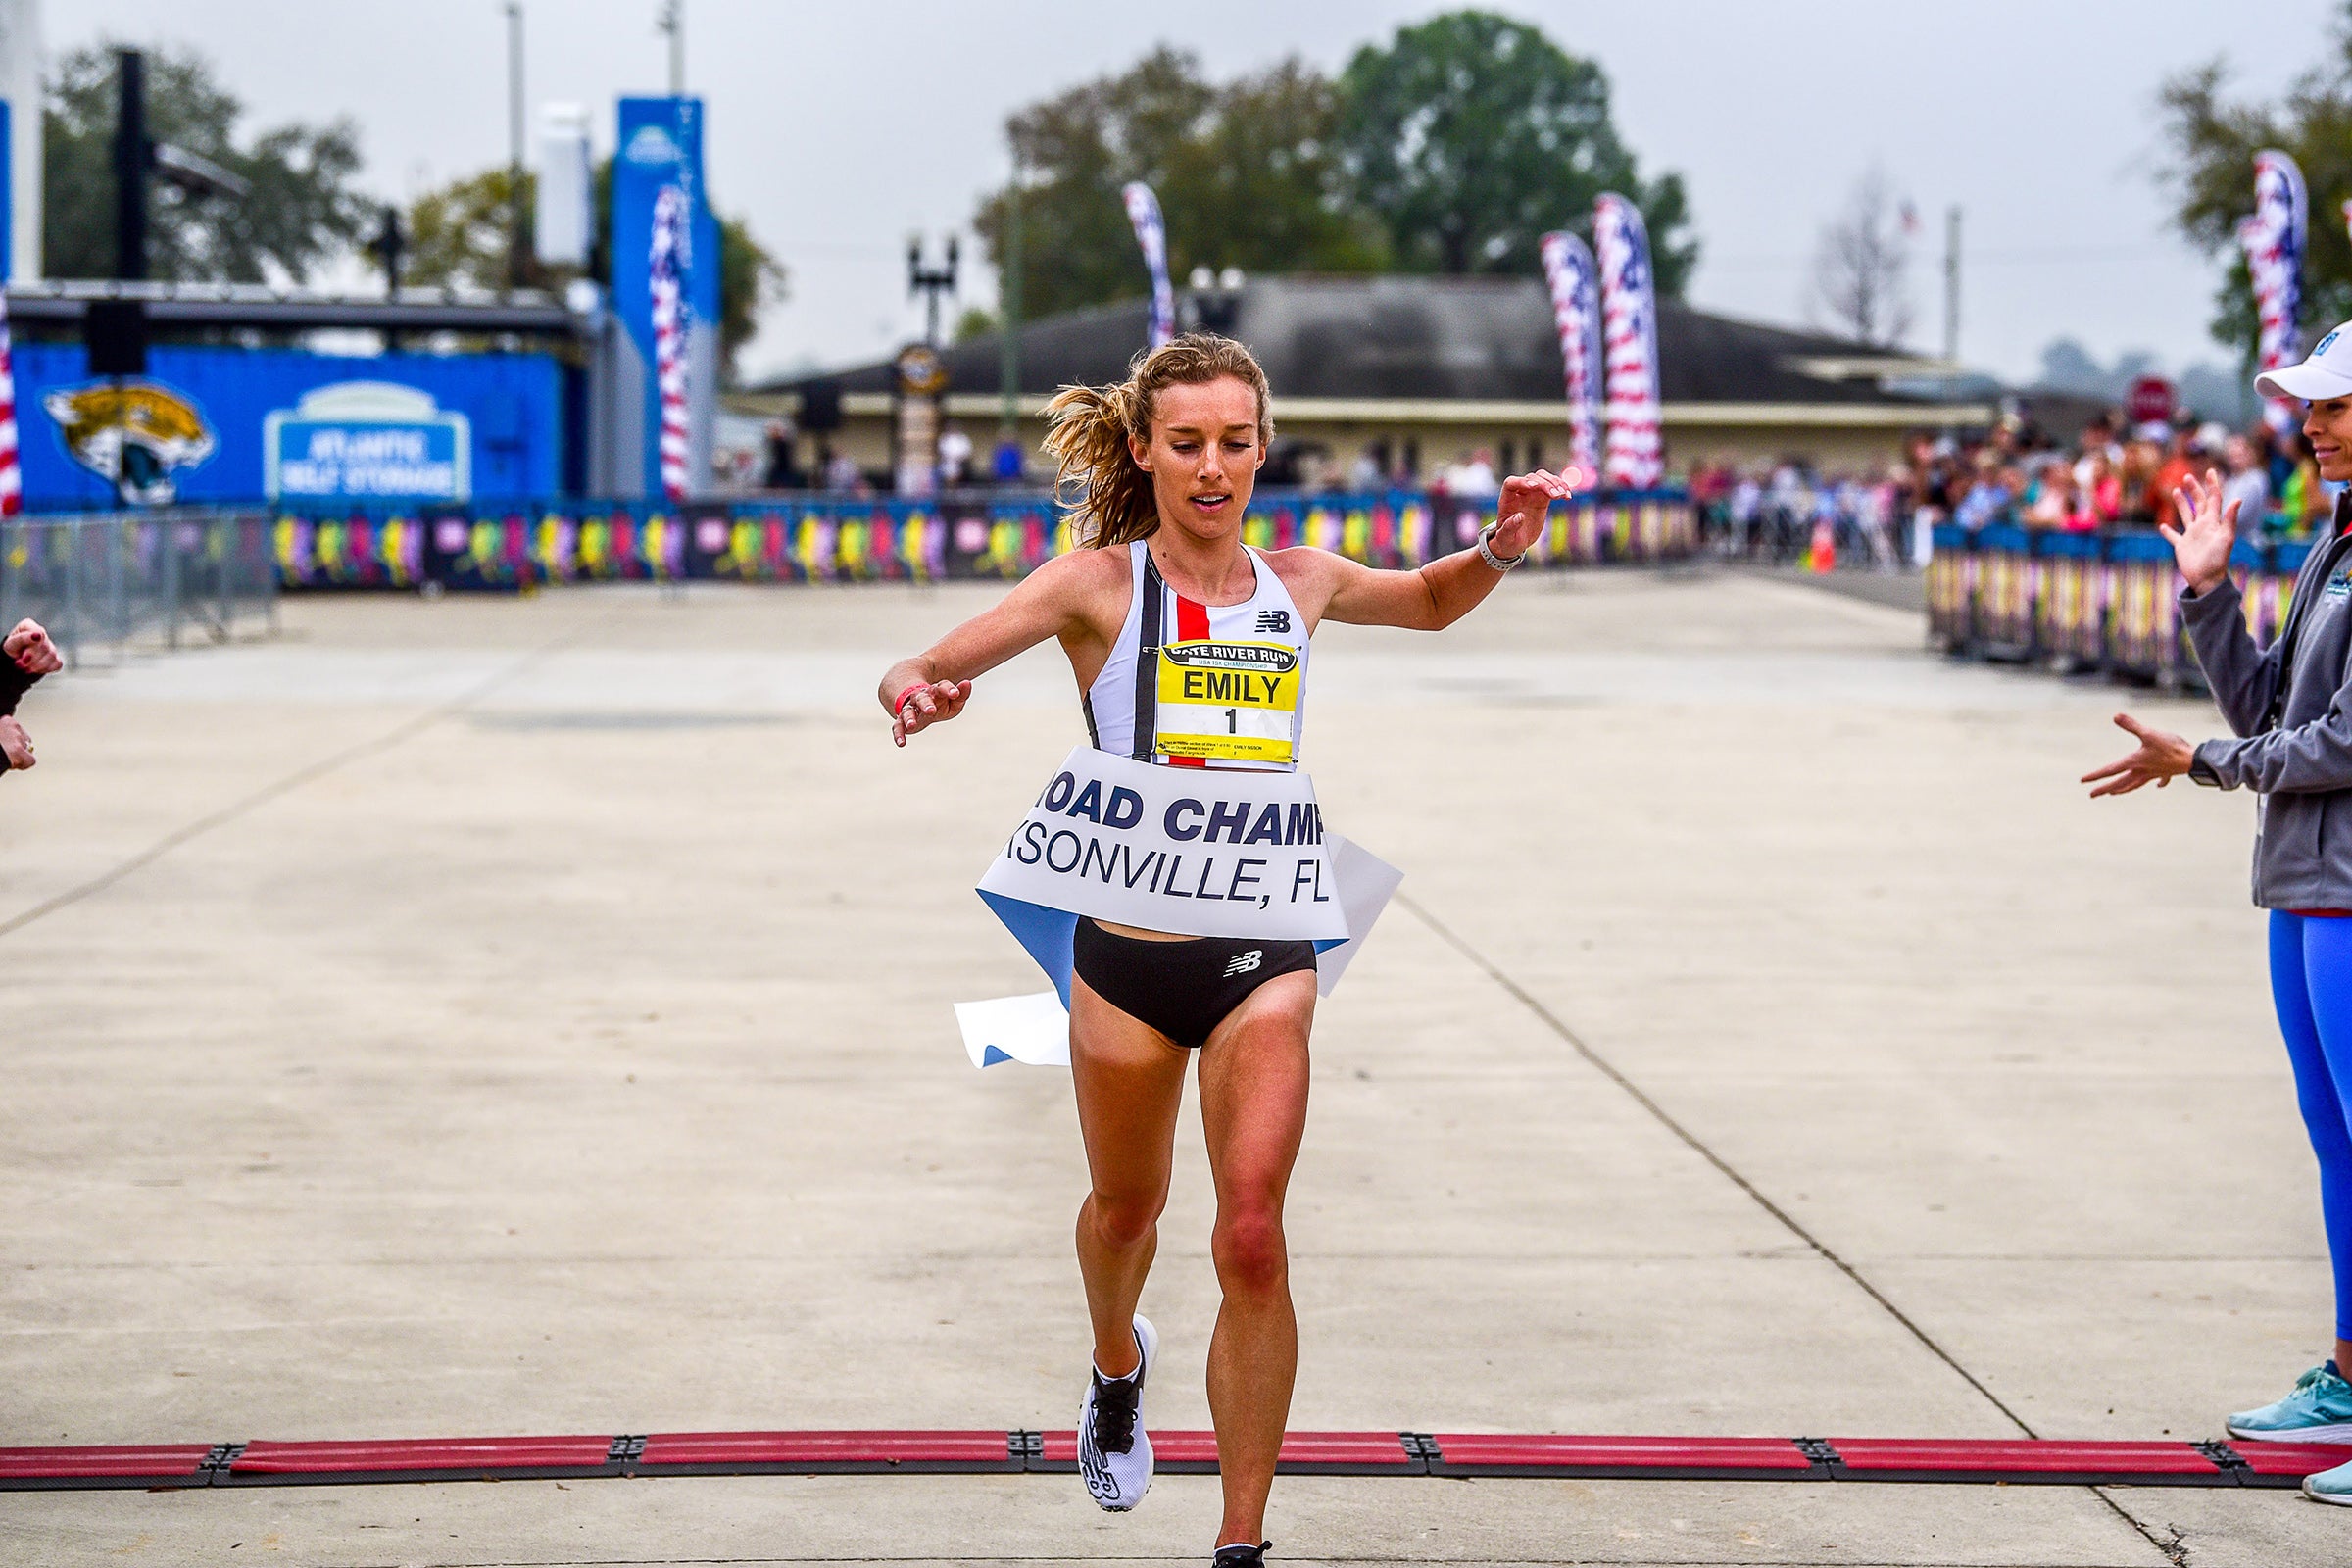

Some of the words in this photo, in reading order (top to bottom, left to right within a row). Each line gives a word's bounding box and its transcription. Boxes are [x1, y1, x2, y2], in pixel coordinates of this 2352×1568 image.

[1212, 646, 1258, 661] RIVER
[1259, 649, 1289, 663] RUN
[1184, 671, 1281, 703] EMILY
[1225, 709, 1237, 734] 1
[1035, 771, 1144, 830] OAD
[1291, 859, 1329, 903] FL
